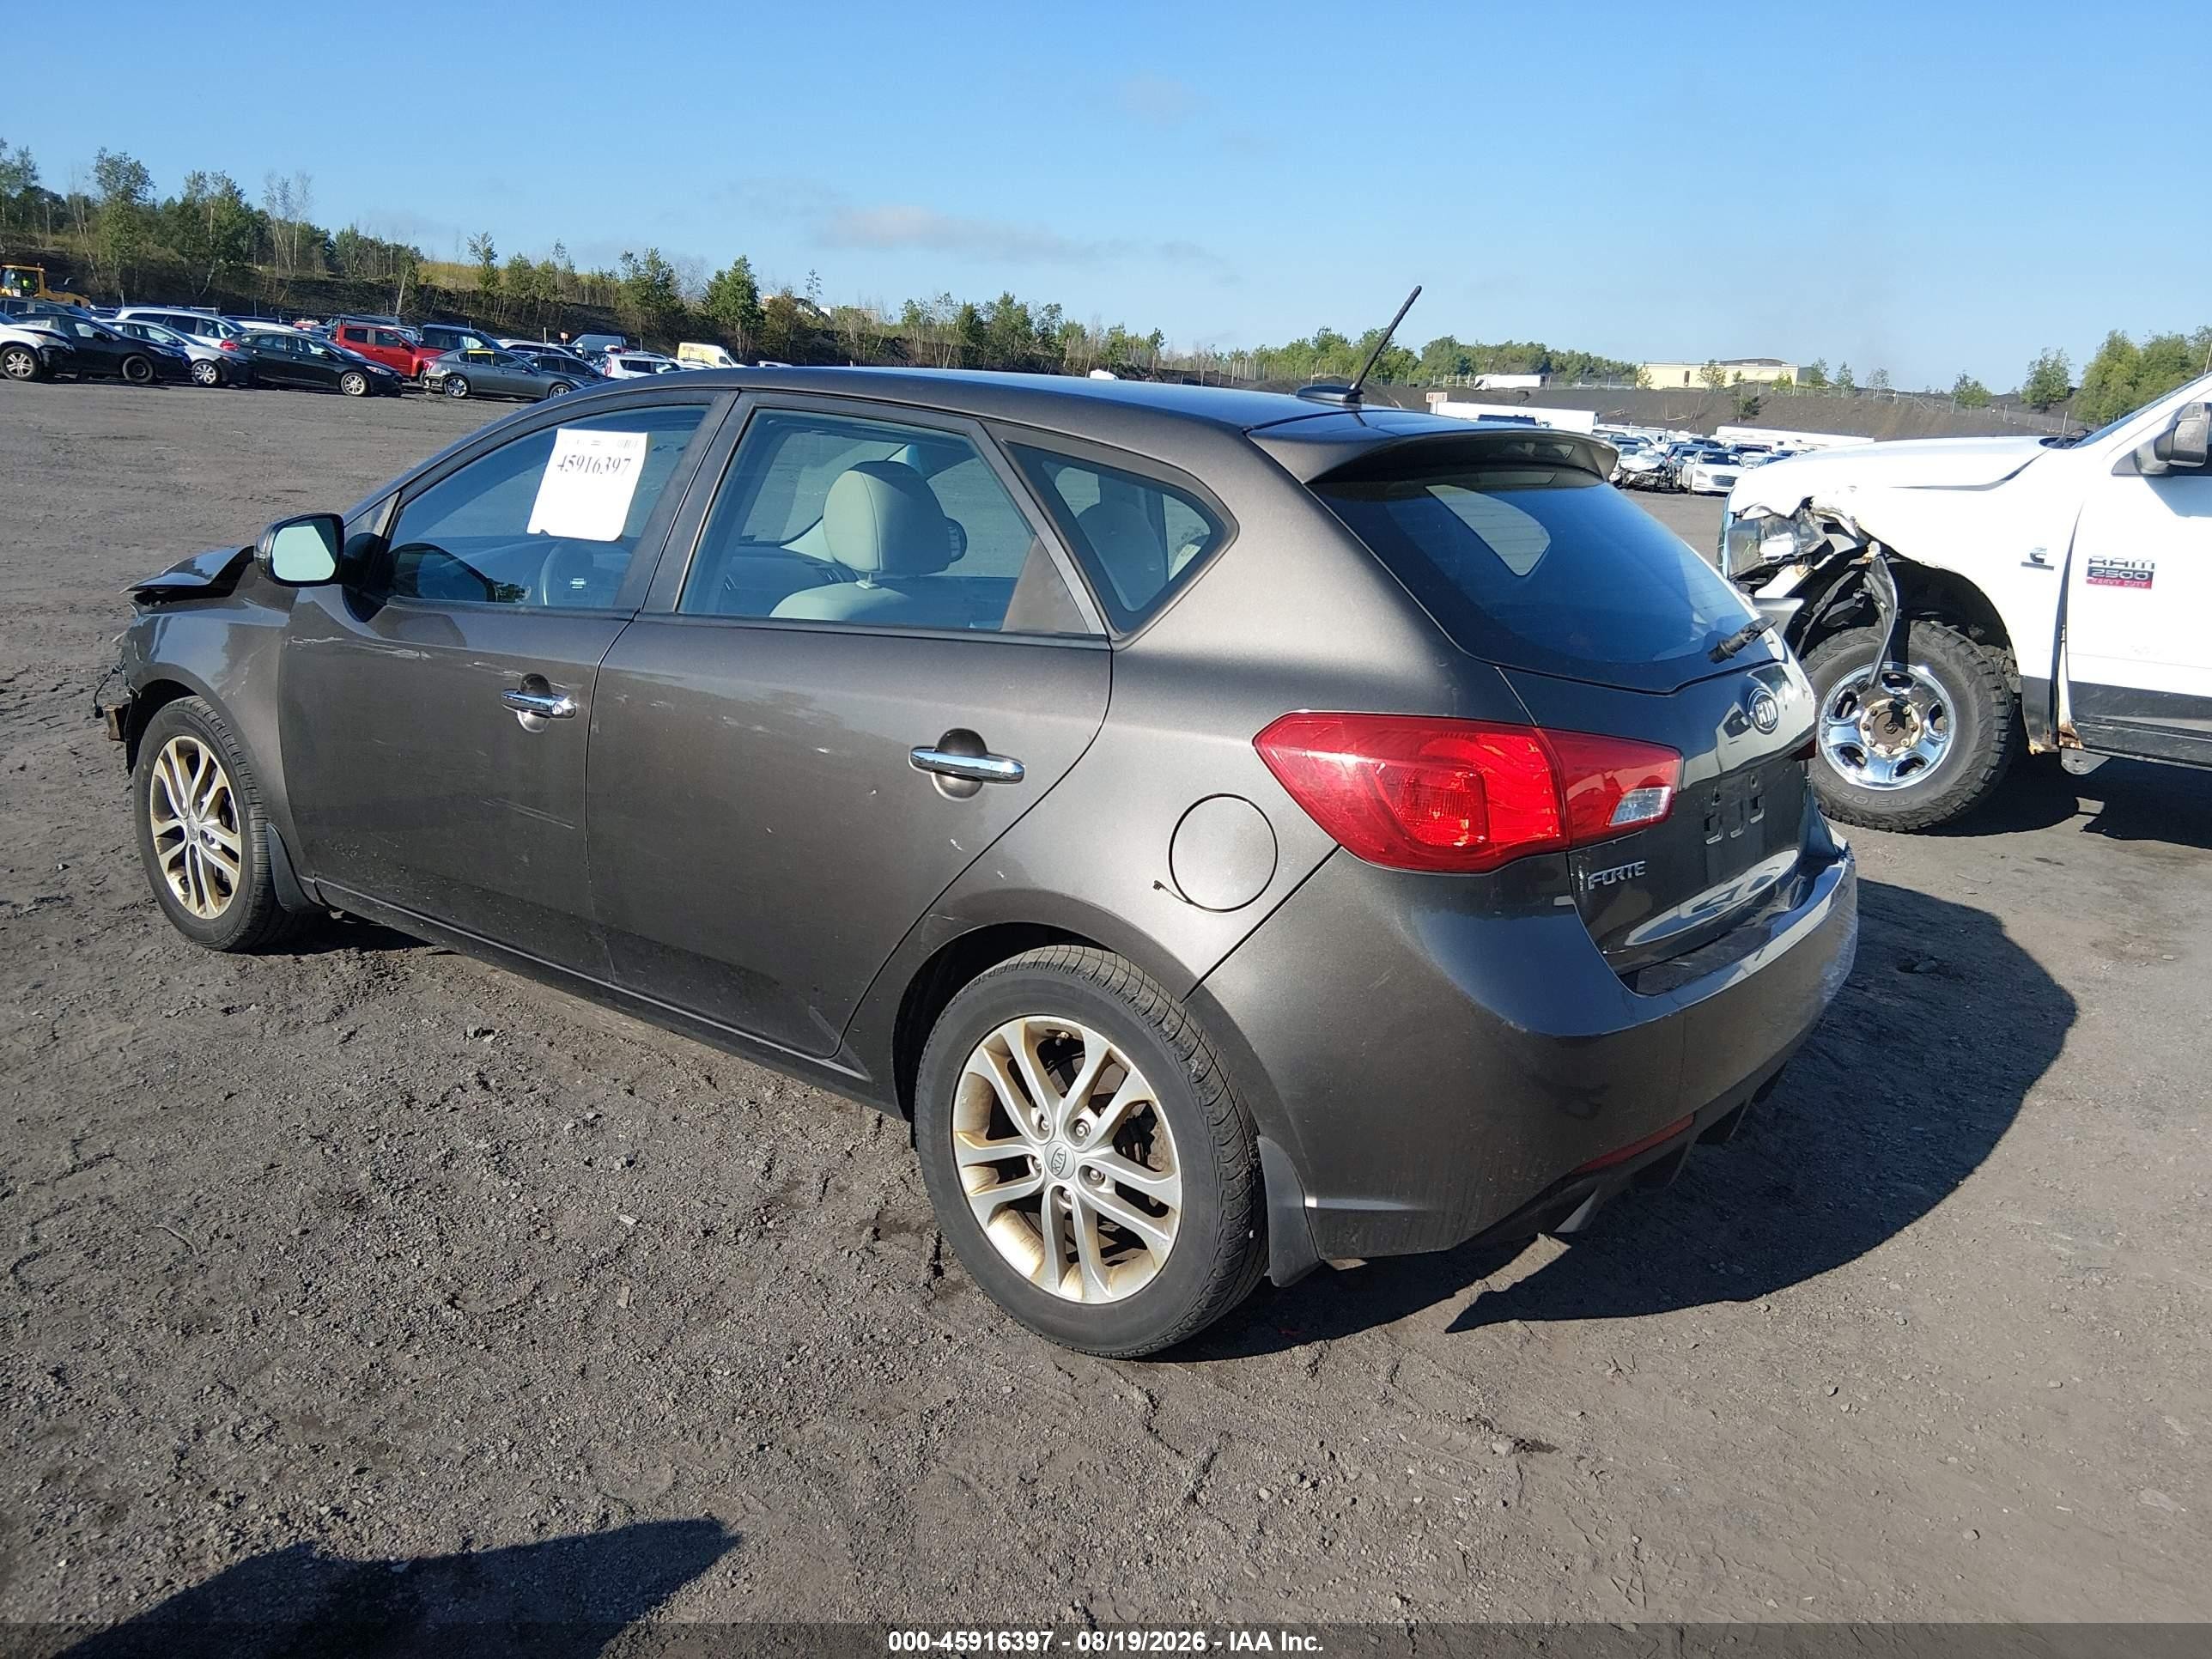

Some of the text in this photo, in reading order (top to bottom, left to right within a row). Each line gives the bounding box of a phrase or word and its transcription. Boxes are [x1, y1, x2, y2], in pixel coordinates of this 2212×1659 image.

[556, 454, 632, 475] 45916397
[2087, 556, 2154, 569] RAM
[2091, 568, 2149, 581] 2500
[1587, 860, 1647, 890] FORTE
[1053, 1152, 1065, 1172] KIA
